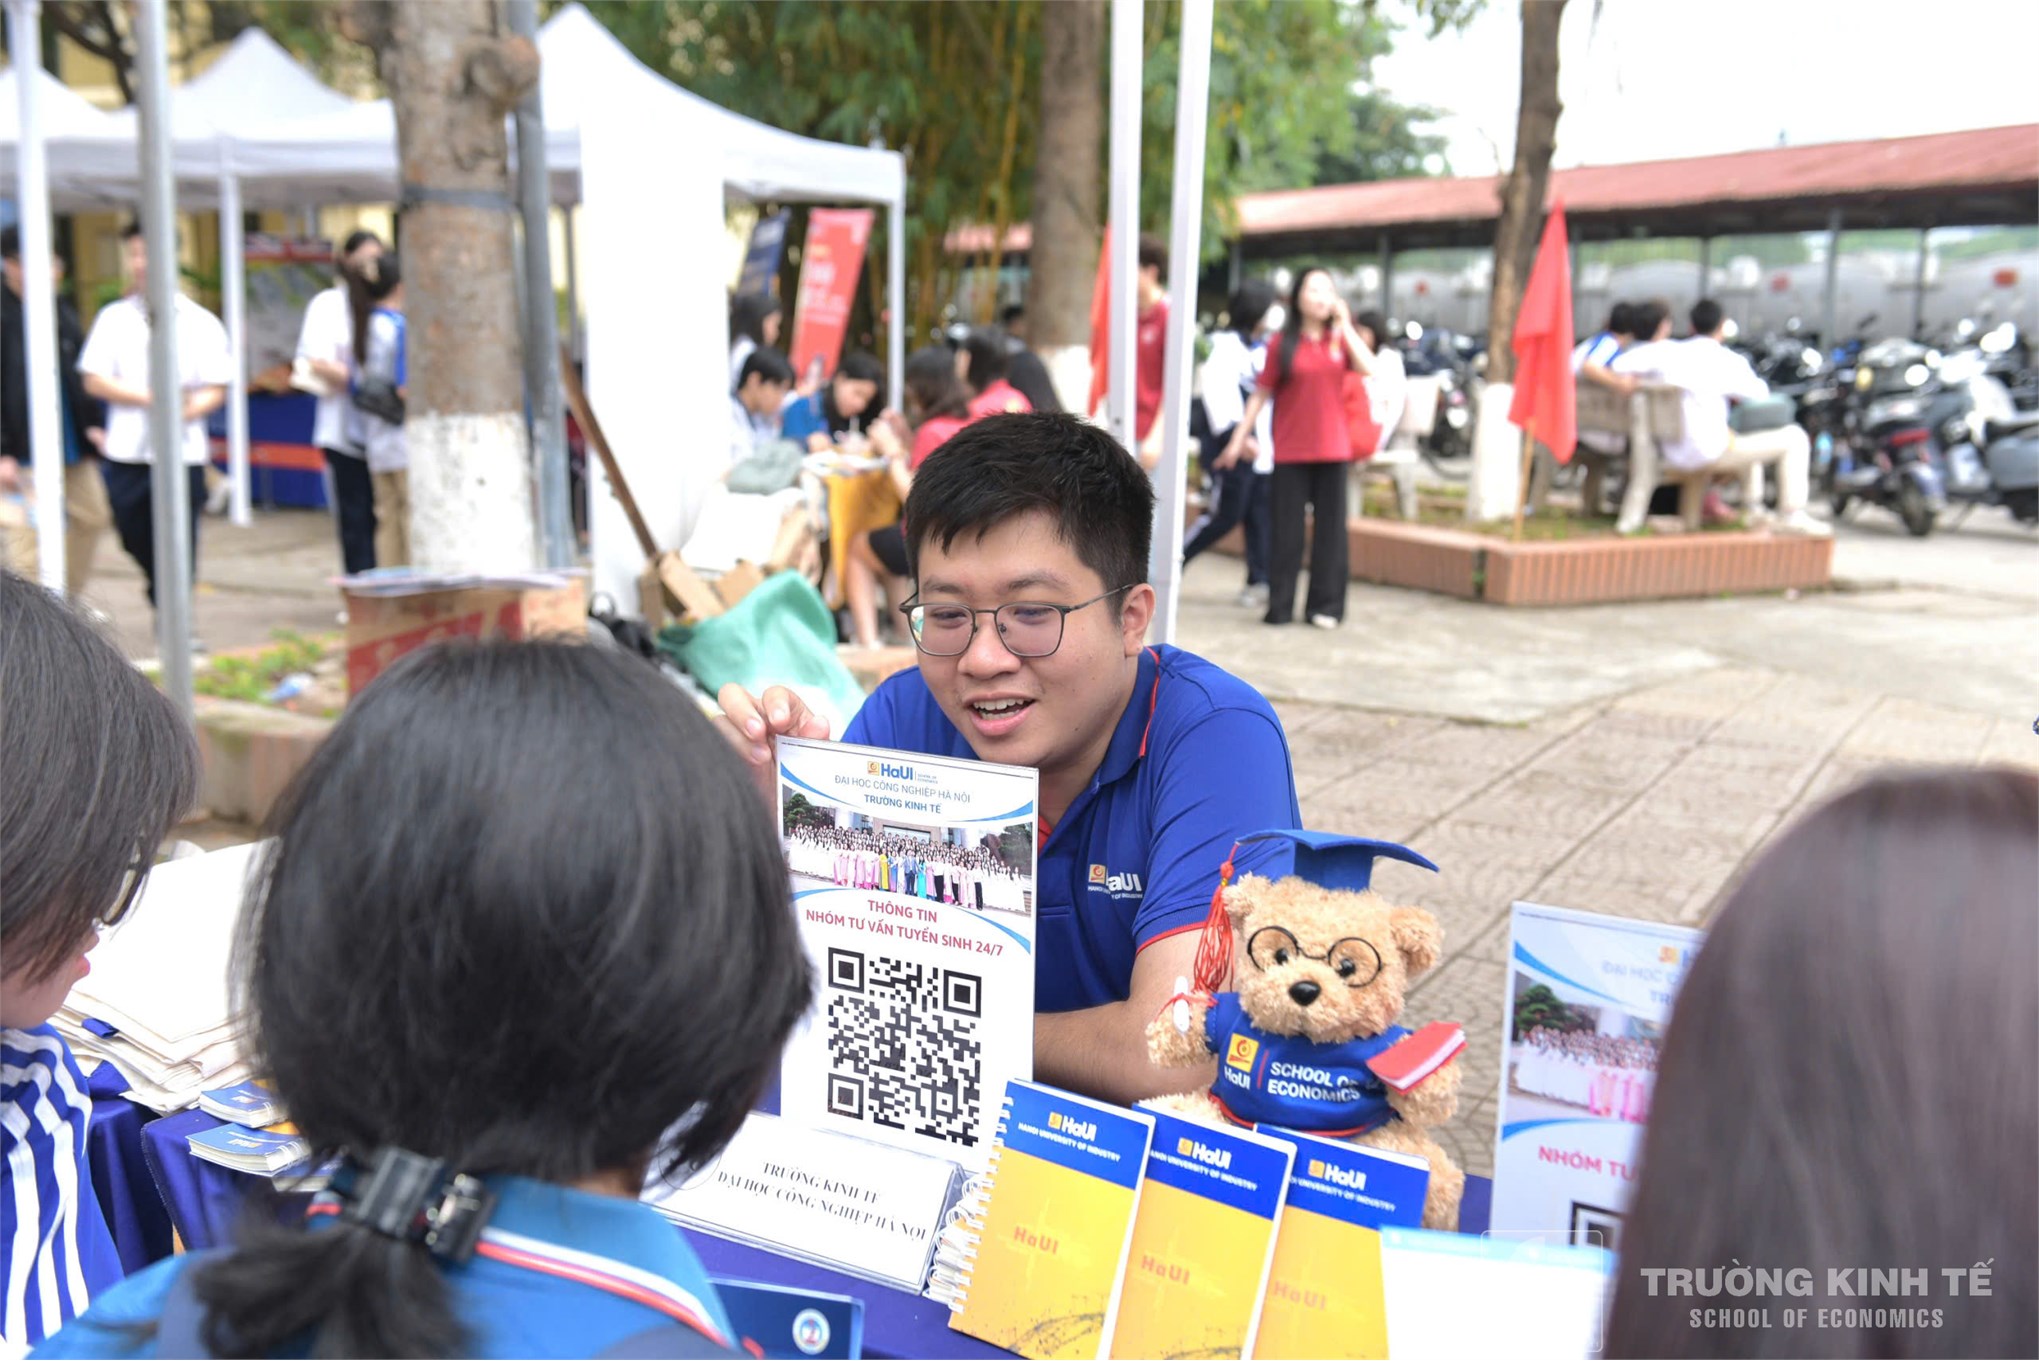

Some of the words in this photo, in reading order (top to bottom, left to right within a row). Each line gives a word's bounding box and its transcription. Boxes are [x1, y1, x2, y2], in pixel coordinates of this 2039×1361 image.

[880, 763, 913, 780] HaUI
[904, 800, 927, 811] KINH
[868, 899, 913, 919] THÔNG
[917, 908, 938, 923] TIN
[806, 909, 845, 927] NHÓM
[848, 917, 866, 930] TƯ
[868, 919, 894, 936] VẤN
[897, 926, 938, 944] TUYỂN
[942, 934, 973, 951] SINH
[976, 940, 1004, 957] 24/7
[1224, 1066, 1251, 1090] HaUI
[1270, 1061, 1333, 1088] SCHOOL
[1267, 1079, 1361, 1103] ECONOMICS
[1061, 1114, 1097, 1142] HaUI
[1192, 1141, 1232, 1170] HaUI
[1324, 1163, 1367, 1191] HaUI
[1013, 1226, 1059, 1255] HaUI
[1141, 1254, 1190, 1285] HaUI
